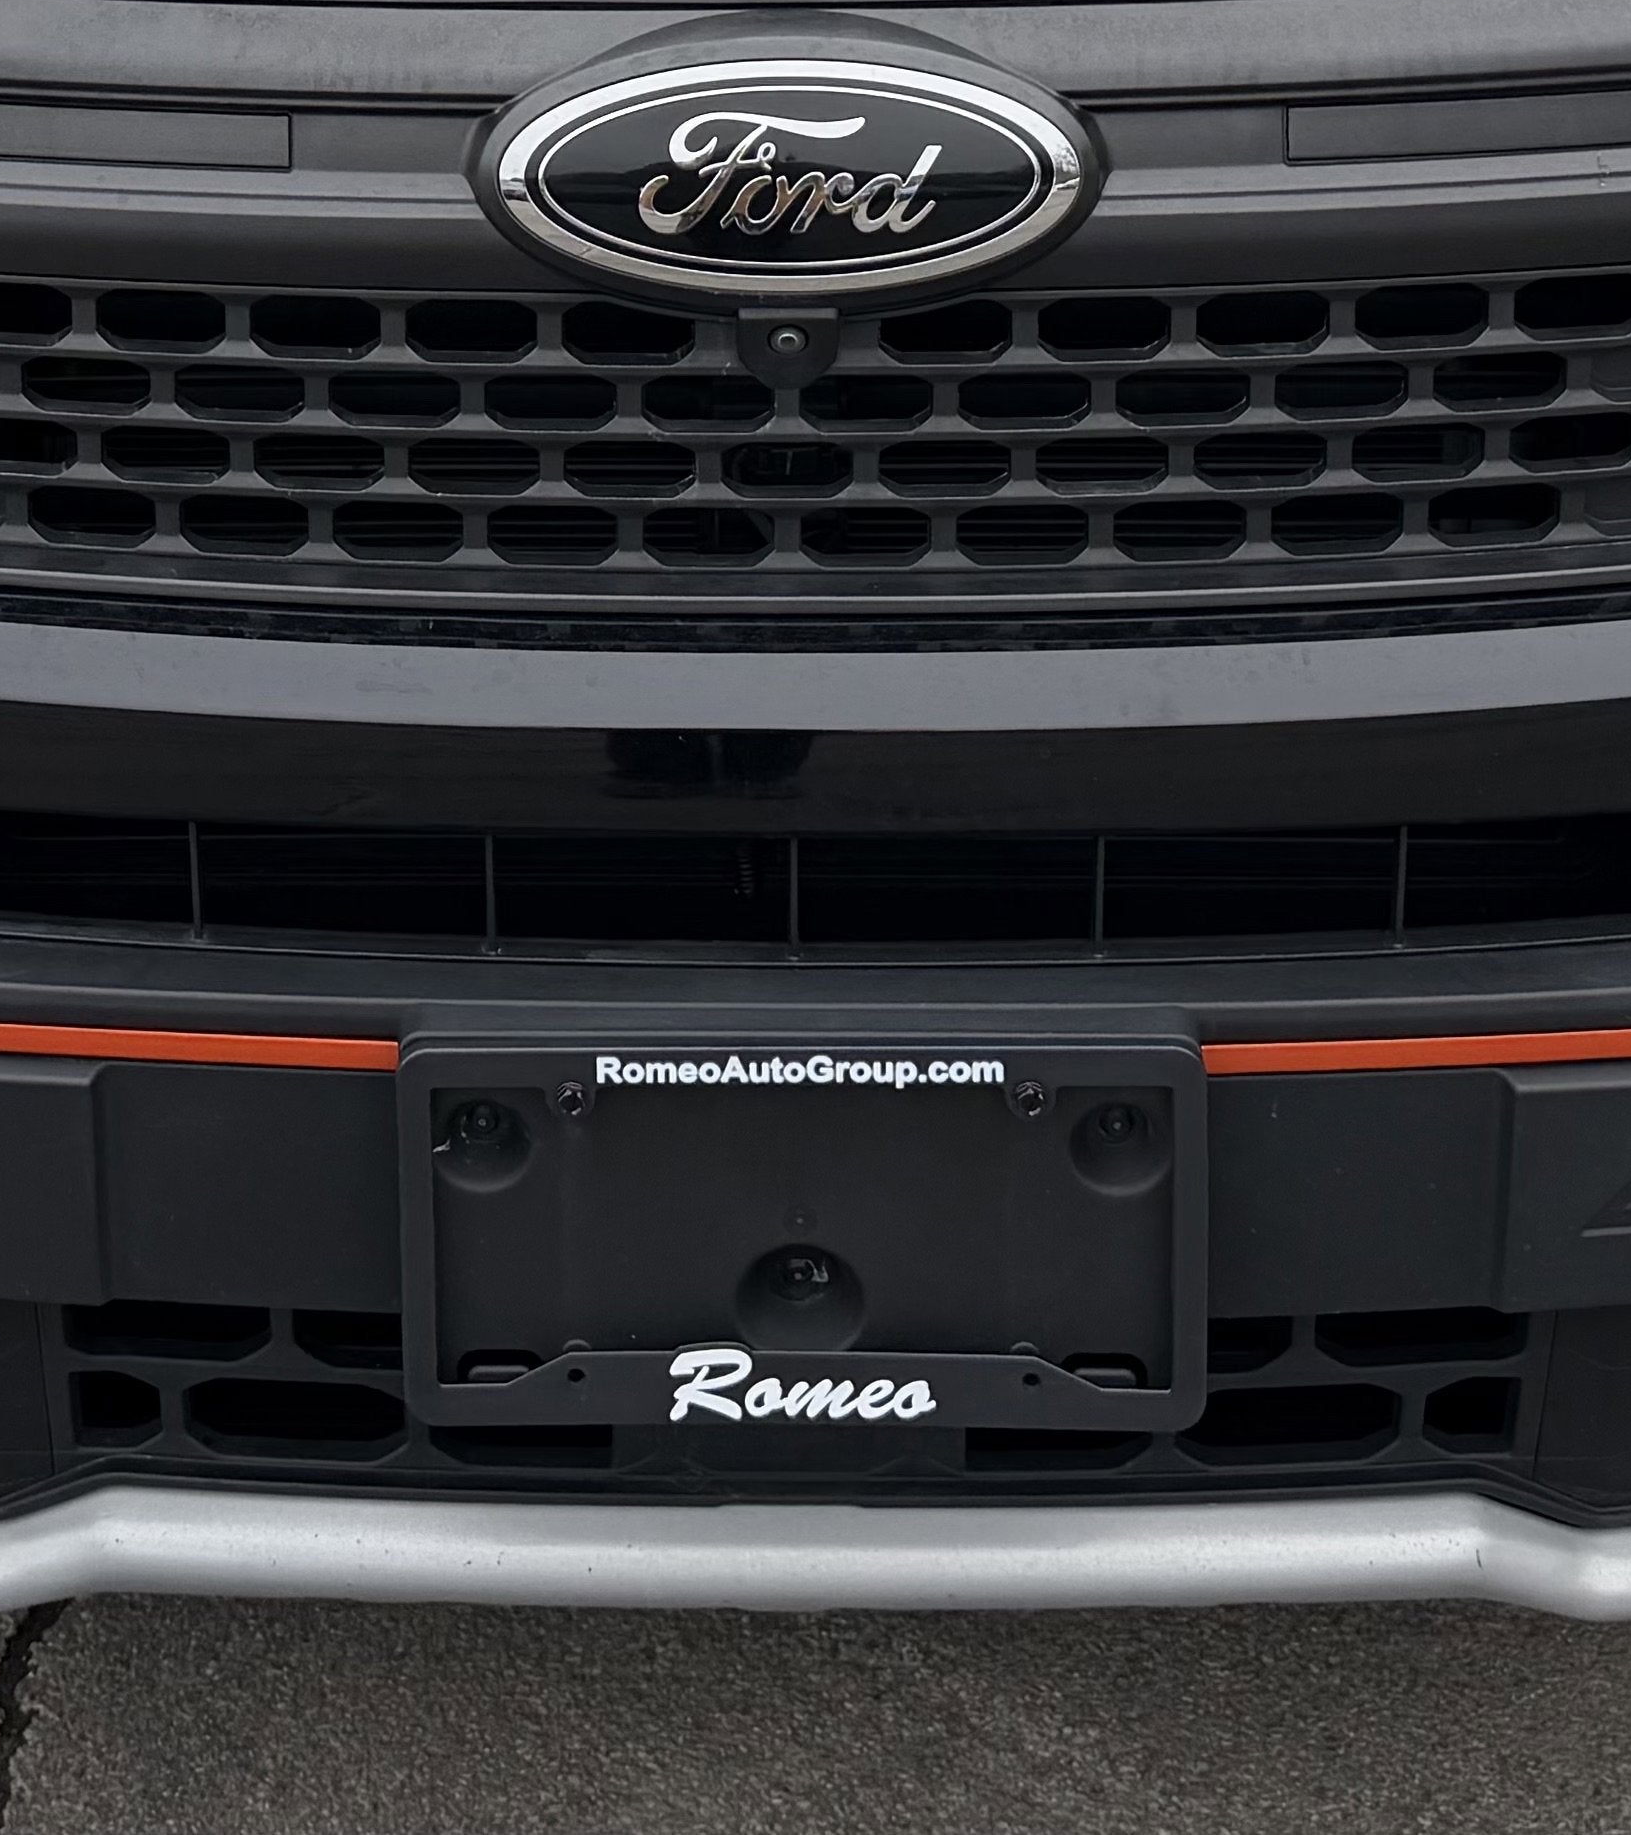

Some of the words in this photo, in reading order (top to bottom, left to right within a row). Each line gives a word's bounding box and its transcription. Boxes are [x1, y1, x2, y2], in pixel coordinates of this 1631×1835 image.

[638, 111, 942, 235] Ford
[595, 1055, 1005, 1087] RomeoAutoGroup.com
[668, 1347, 936, 1422] Romeo
